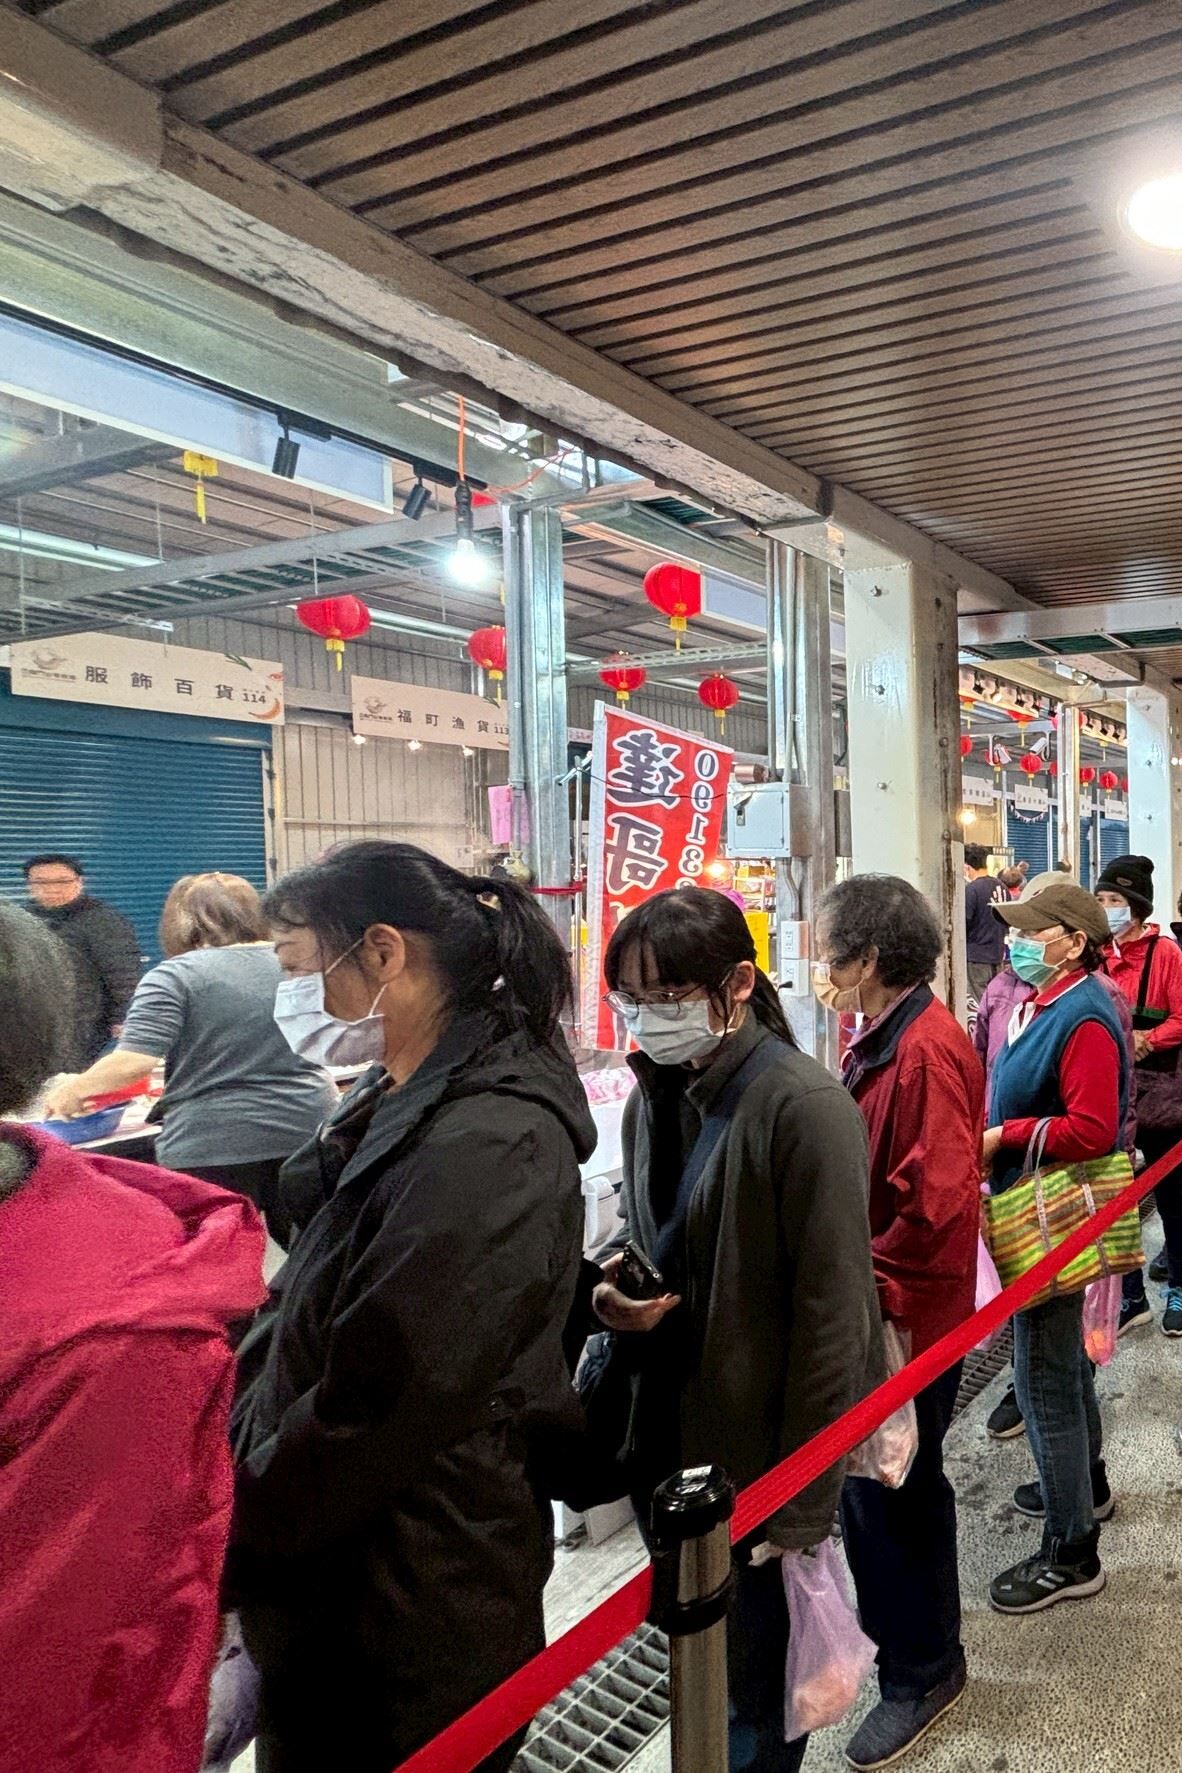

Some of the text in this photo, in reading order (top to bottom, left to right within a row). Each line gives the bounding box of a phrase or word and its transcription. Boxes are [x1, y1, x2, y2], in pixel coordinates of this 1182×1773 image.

[85, 665, 234, 701] 服飾百貨
[242, 692, 266, 704] 114
[397, 708, 489, 733] 福町漁貨
